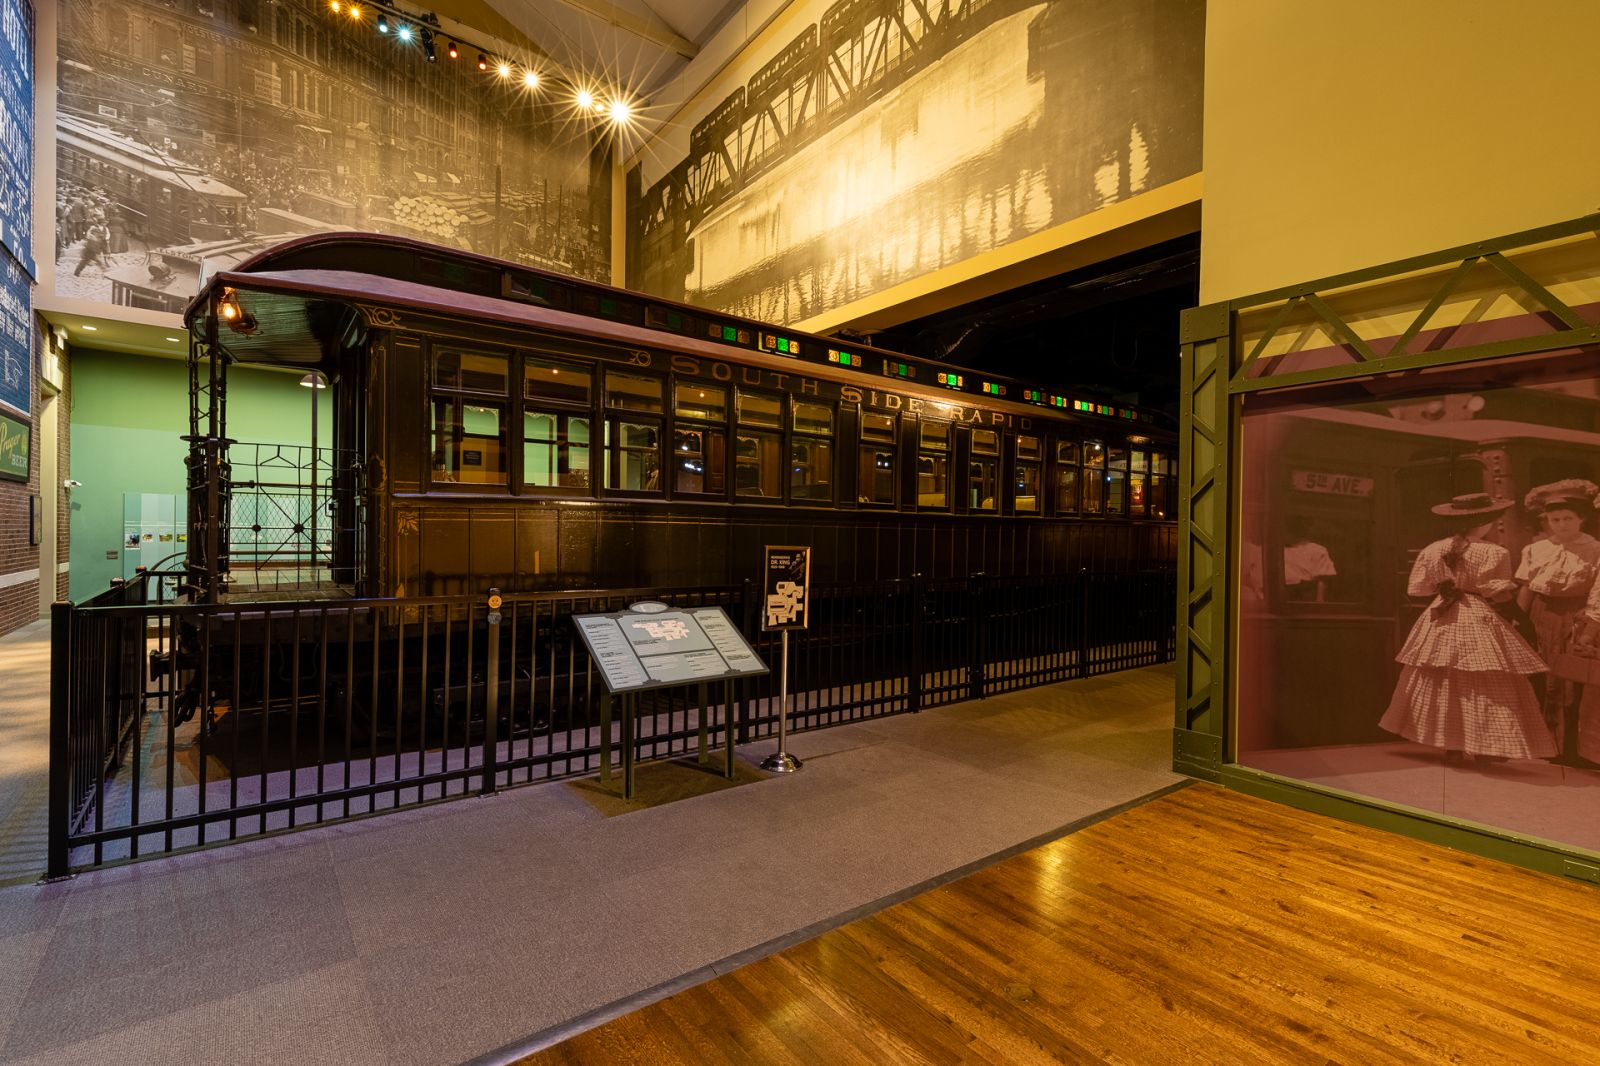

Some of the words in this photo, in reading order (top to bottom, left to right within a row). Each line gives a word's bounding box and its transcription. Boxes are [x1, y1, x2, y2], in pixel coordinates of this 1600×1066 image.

[2, 0, 28, 80] HOTEL
[670, 355, 819, 396] SOUTH
[840, 385, 924, 414] SIDE
[951, 406, 1033, 431] RAPID
[11, 454, 28, 469] BEER
